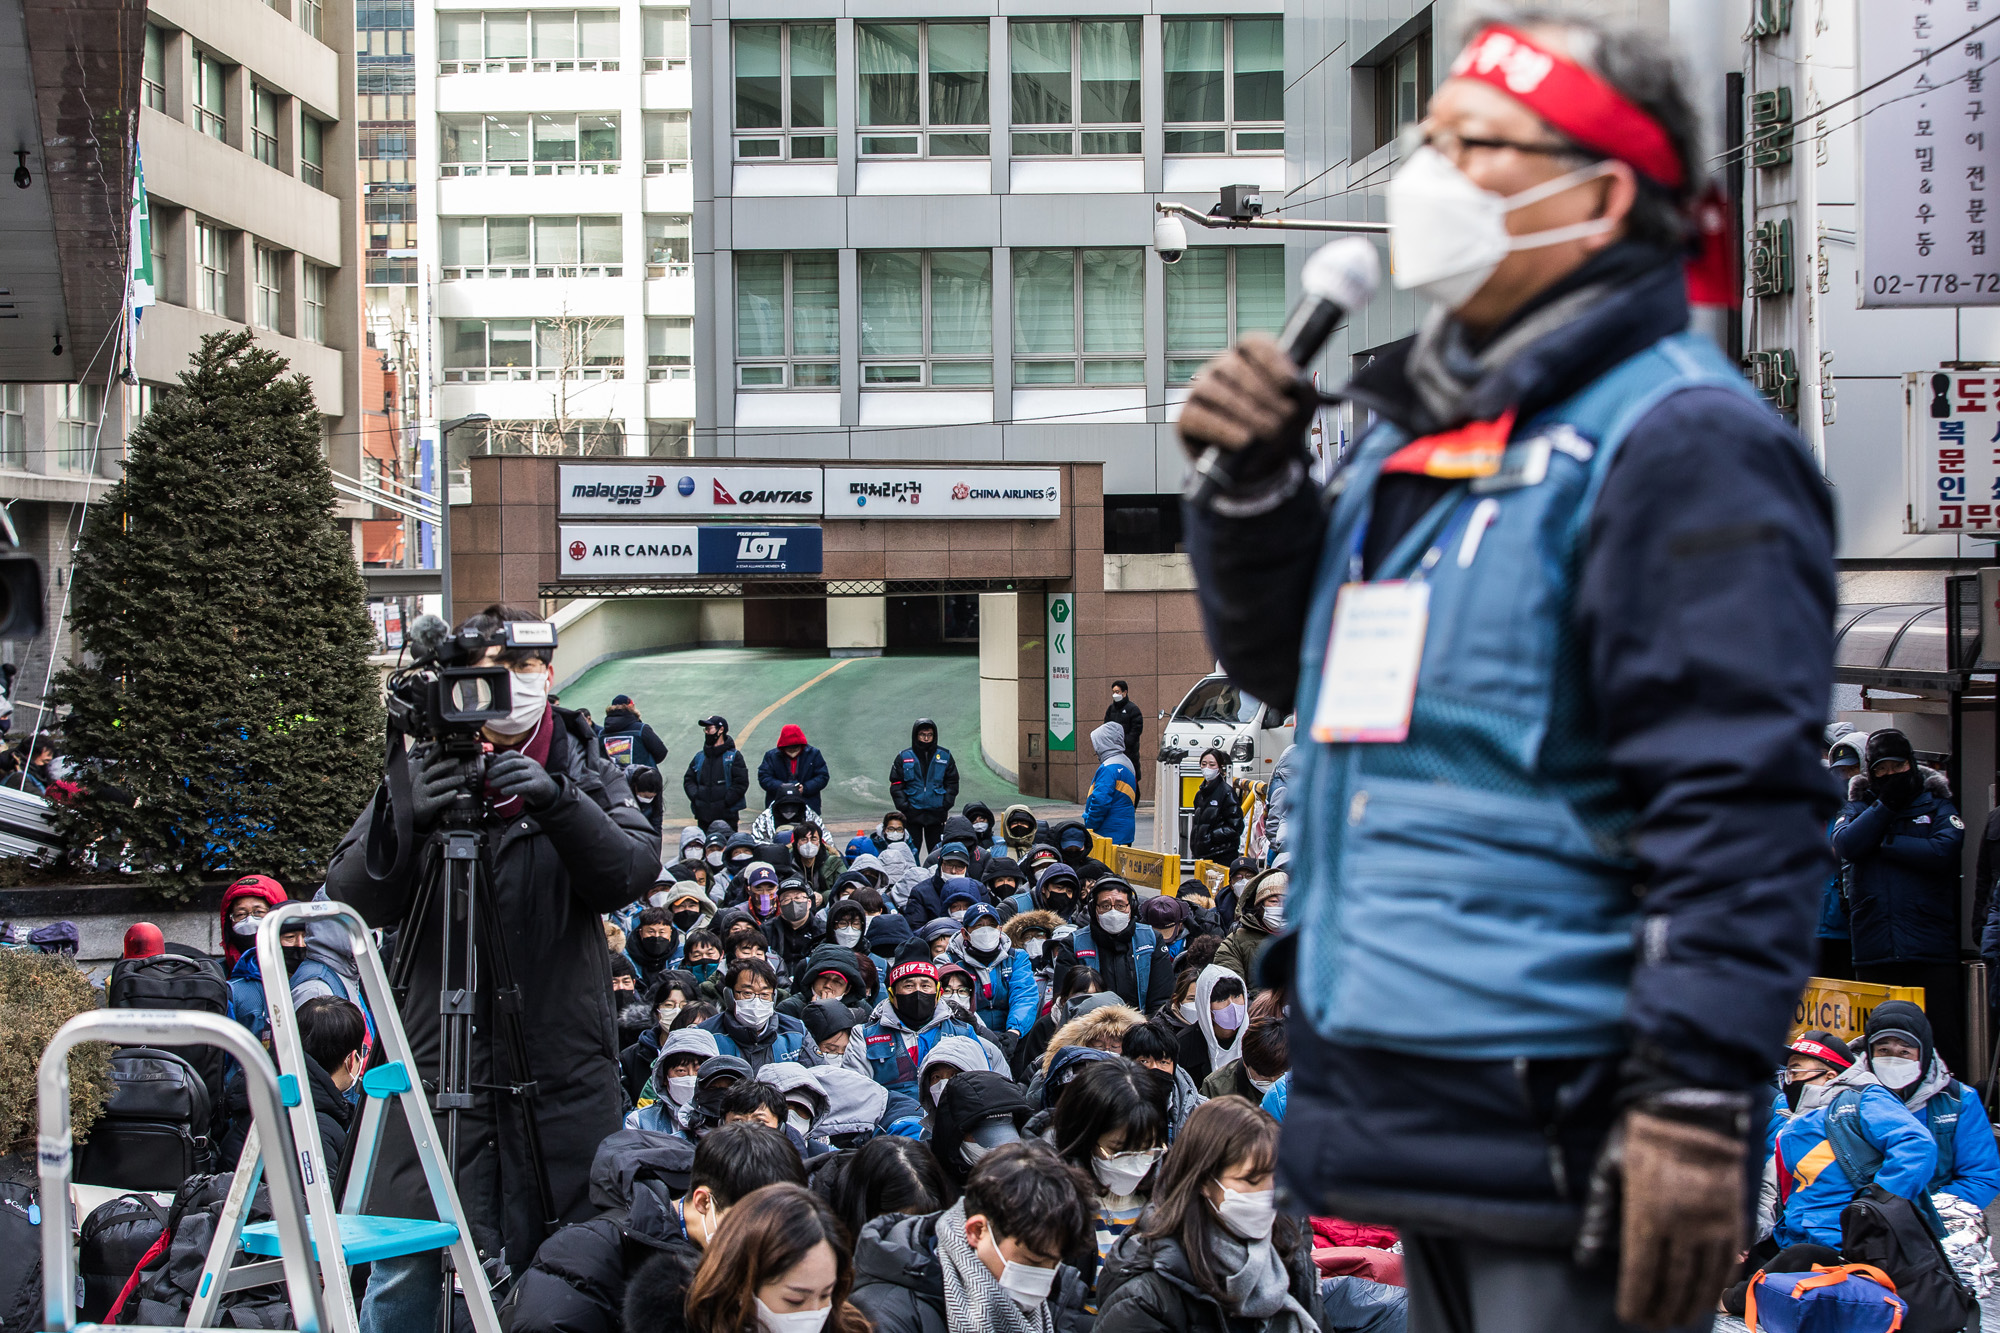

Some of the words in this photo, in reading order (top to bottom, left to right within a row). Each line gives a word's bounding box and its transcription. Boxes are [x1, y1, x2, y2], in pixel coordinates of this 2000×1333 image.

[1912, 0, 1935, 257] 돈가스·모밀&우동
[572, 482, 644, 503] malaysia
[738, 490, 813, 504] QANTAS
[849, 481, 922, 507] 땡처리닷컴
[969, 489, 1000, 499] CHINA
[1002, 489, 1044, 499] AIRLINES
[592, 544, 620, 557] AIR
[625, 544, 693, 557] CANADA
[736, 537, 788, 560] LOT
[1056, 603, 1065, 619] P
[1793, 1000, 1841, 1030] OLICE
